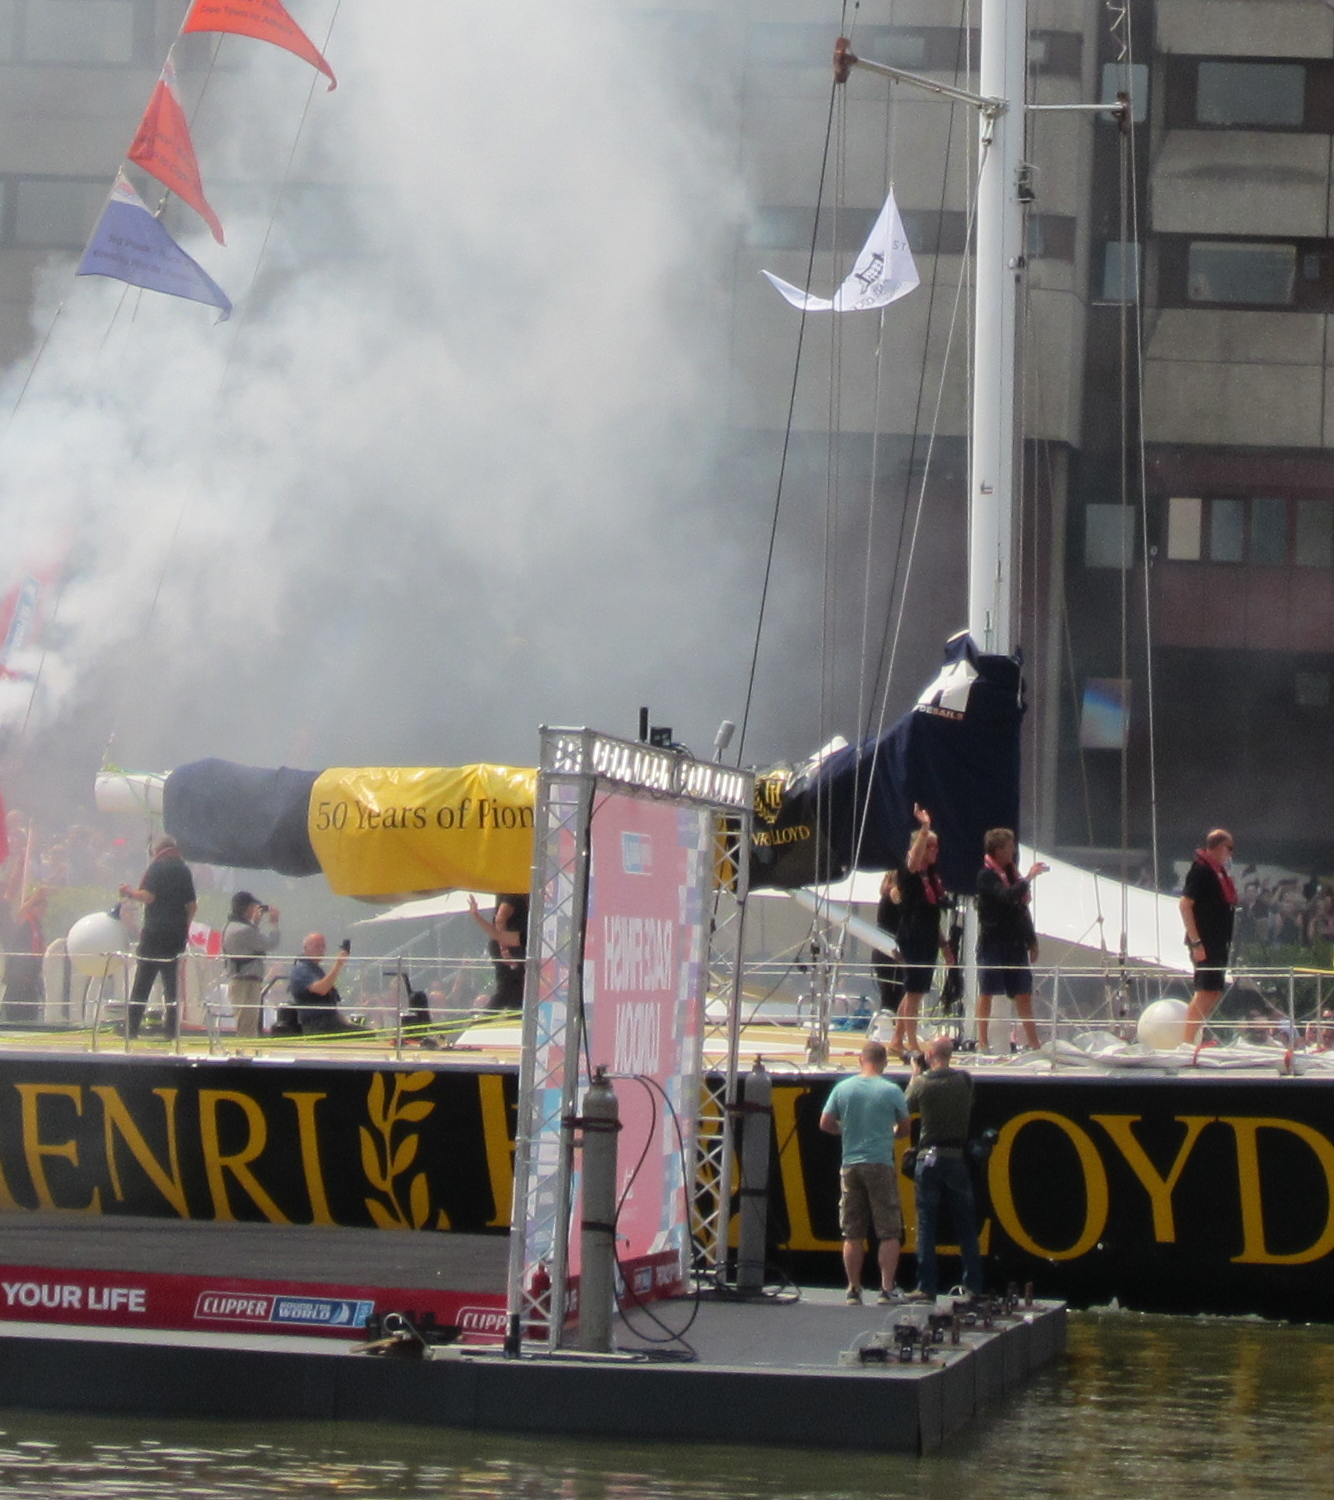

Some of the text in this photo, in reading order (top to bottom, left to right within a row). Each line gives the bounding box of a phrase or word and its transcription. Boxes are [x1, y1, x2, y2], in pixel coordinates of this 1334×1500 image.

[316, 797, 535, 831] 50 Years of Pion
[1, 1281, 83, 1310] YOUR
[88, 1285, 146, 1313] LIFE
[202, 1297, 267, 1317] CLIPPER
[278, 1307, 331, 1320] WORLD
[463, 1311, 507, 1331] CLIPP
